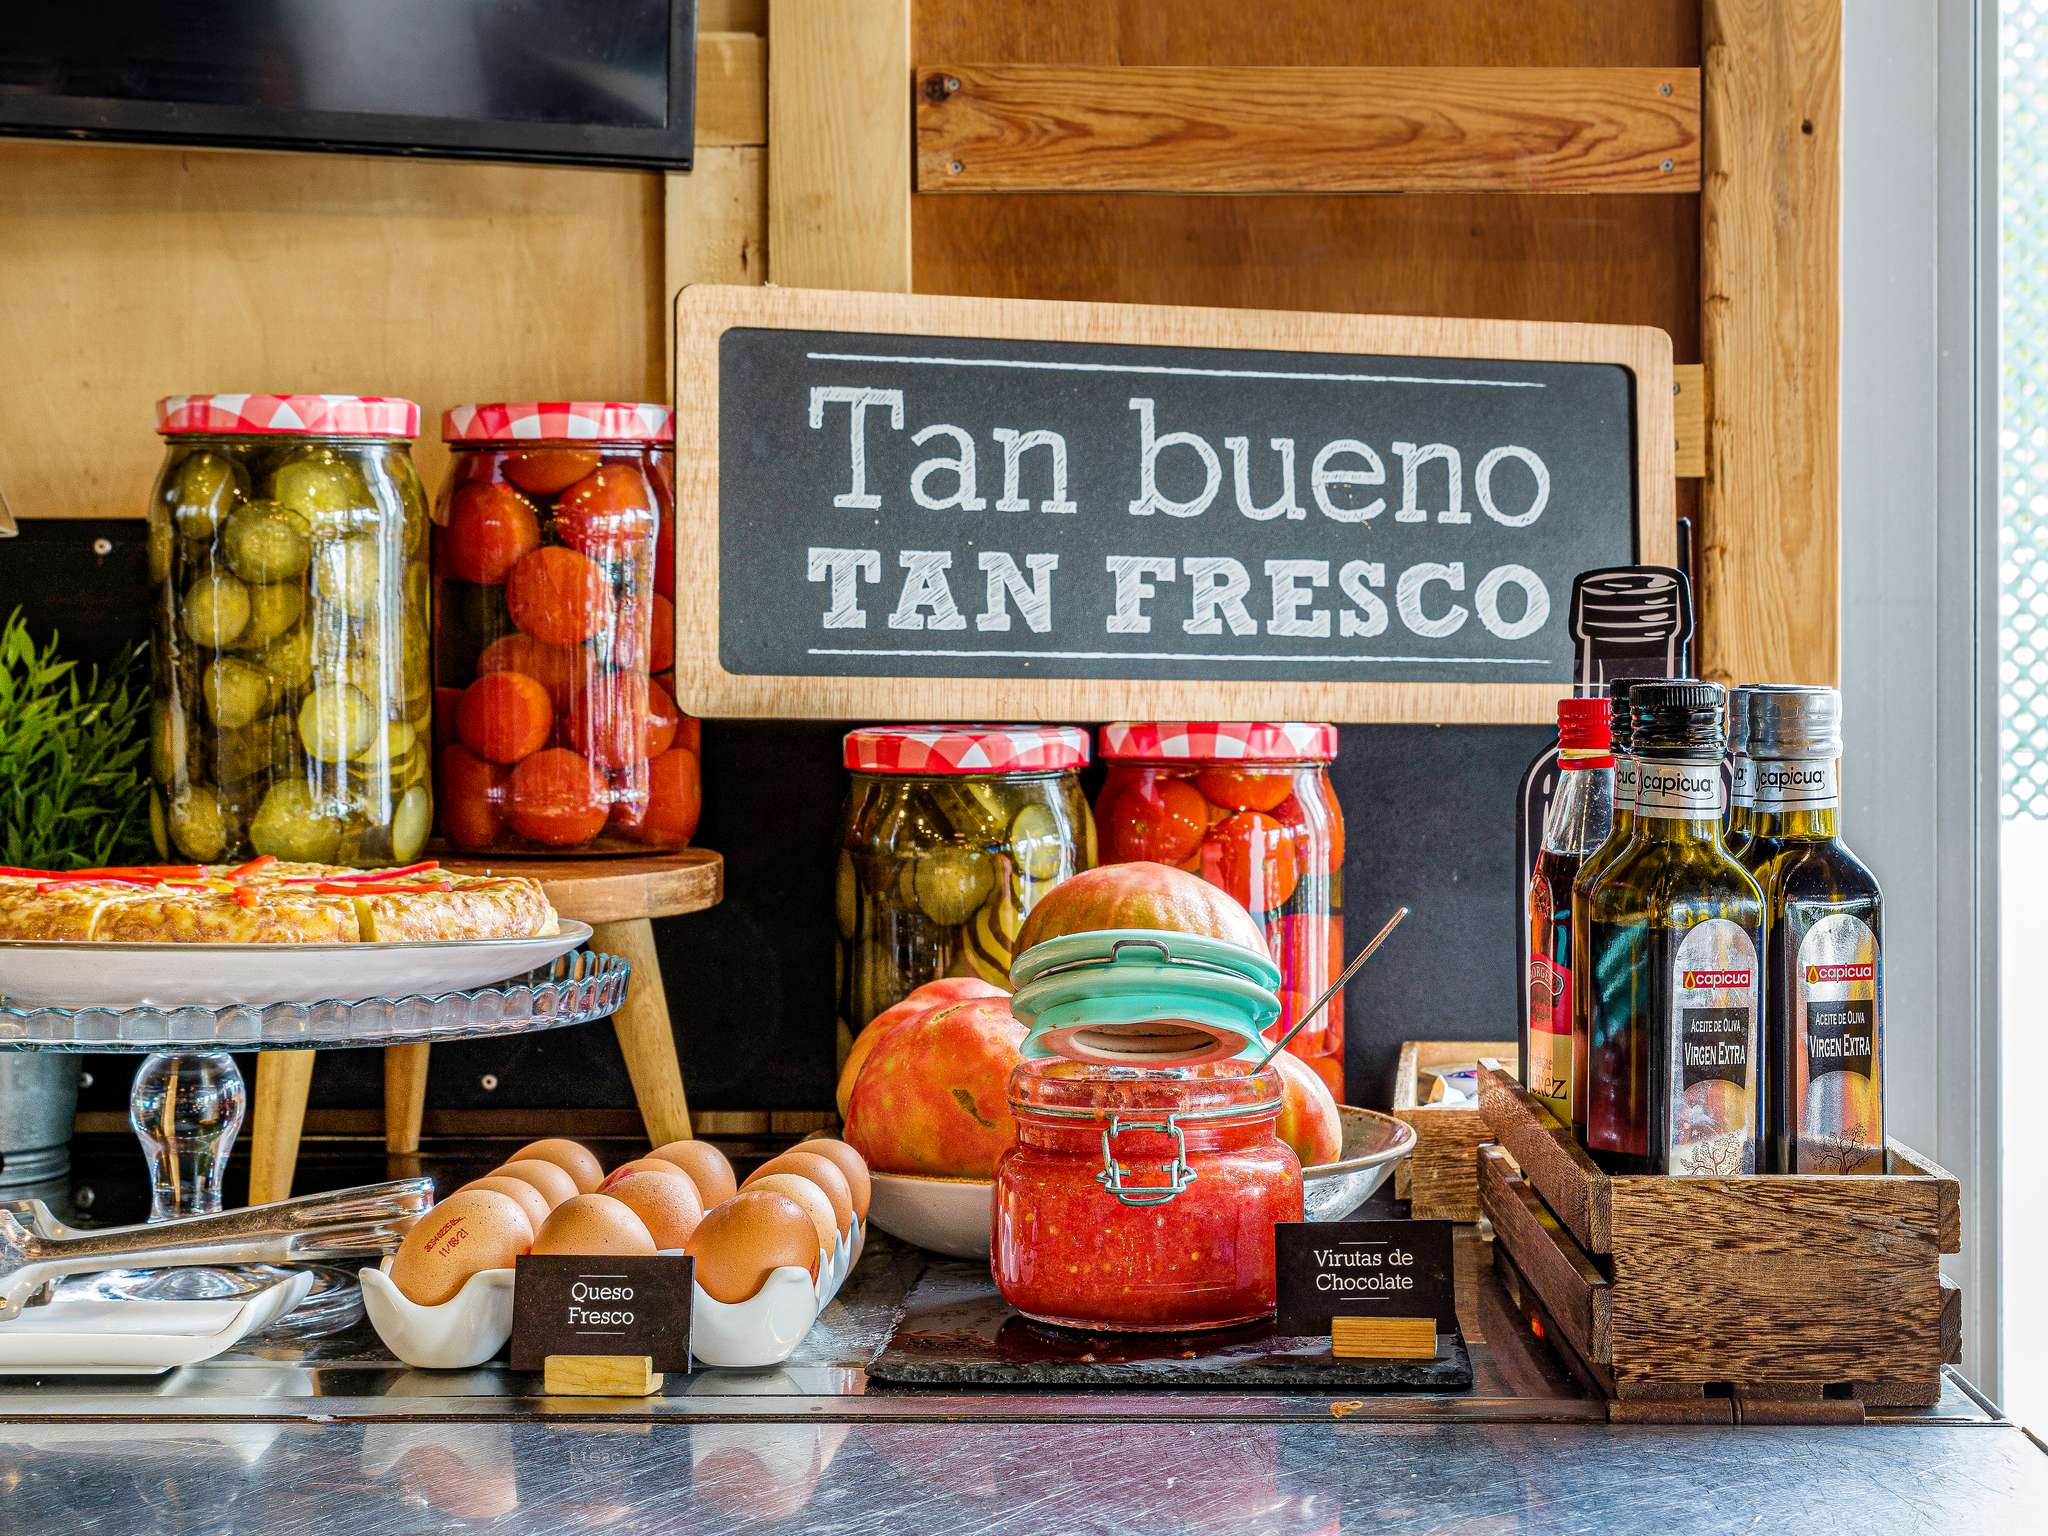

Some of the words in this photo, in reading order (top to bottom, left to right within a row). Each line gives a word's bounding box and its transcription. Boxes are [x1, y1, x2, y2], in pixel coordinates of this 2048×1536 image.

[809, 387, 1077, 513] Tan
[1129, 397, 1551, 528] bueno
[807, 547, 1059, 633] TAN
[1106, 555, 1551, 640] FRESCO
[1643, 772, 1712, 797] capicua
[1760, 767, 1824, 792] capicua
[1695, 970, 1749, 990] capicua
[1818, 963, 1872, 983] capicua
[1684, 1042, 1717, 1066] VIRGEN
[1718, 1041, 1746, 1066] EXTRA
[1809, 1035, 1842, 1058] VIRGEN
[1843, 1033, 1871, 1056] EXTRA
[1313, 1249, 1382, 1268] Virutas
[1388, 1248, 1414, 1266] de
[571, 1282, 634, 1303] Queso
[1316, 1273, 1414, 1291] Chocolate
[567, 1307, 635, 1325] Fresco
